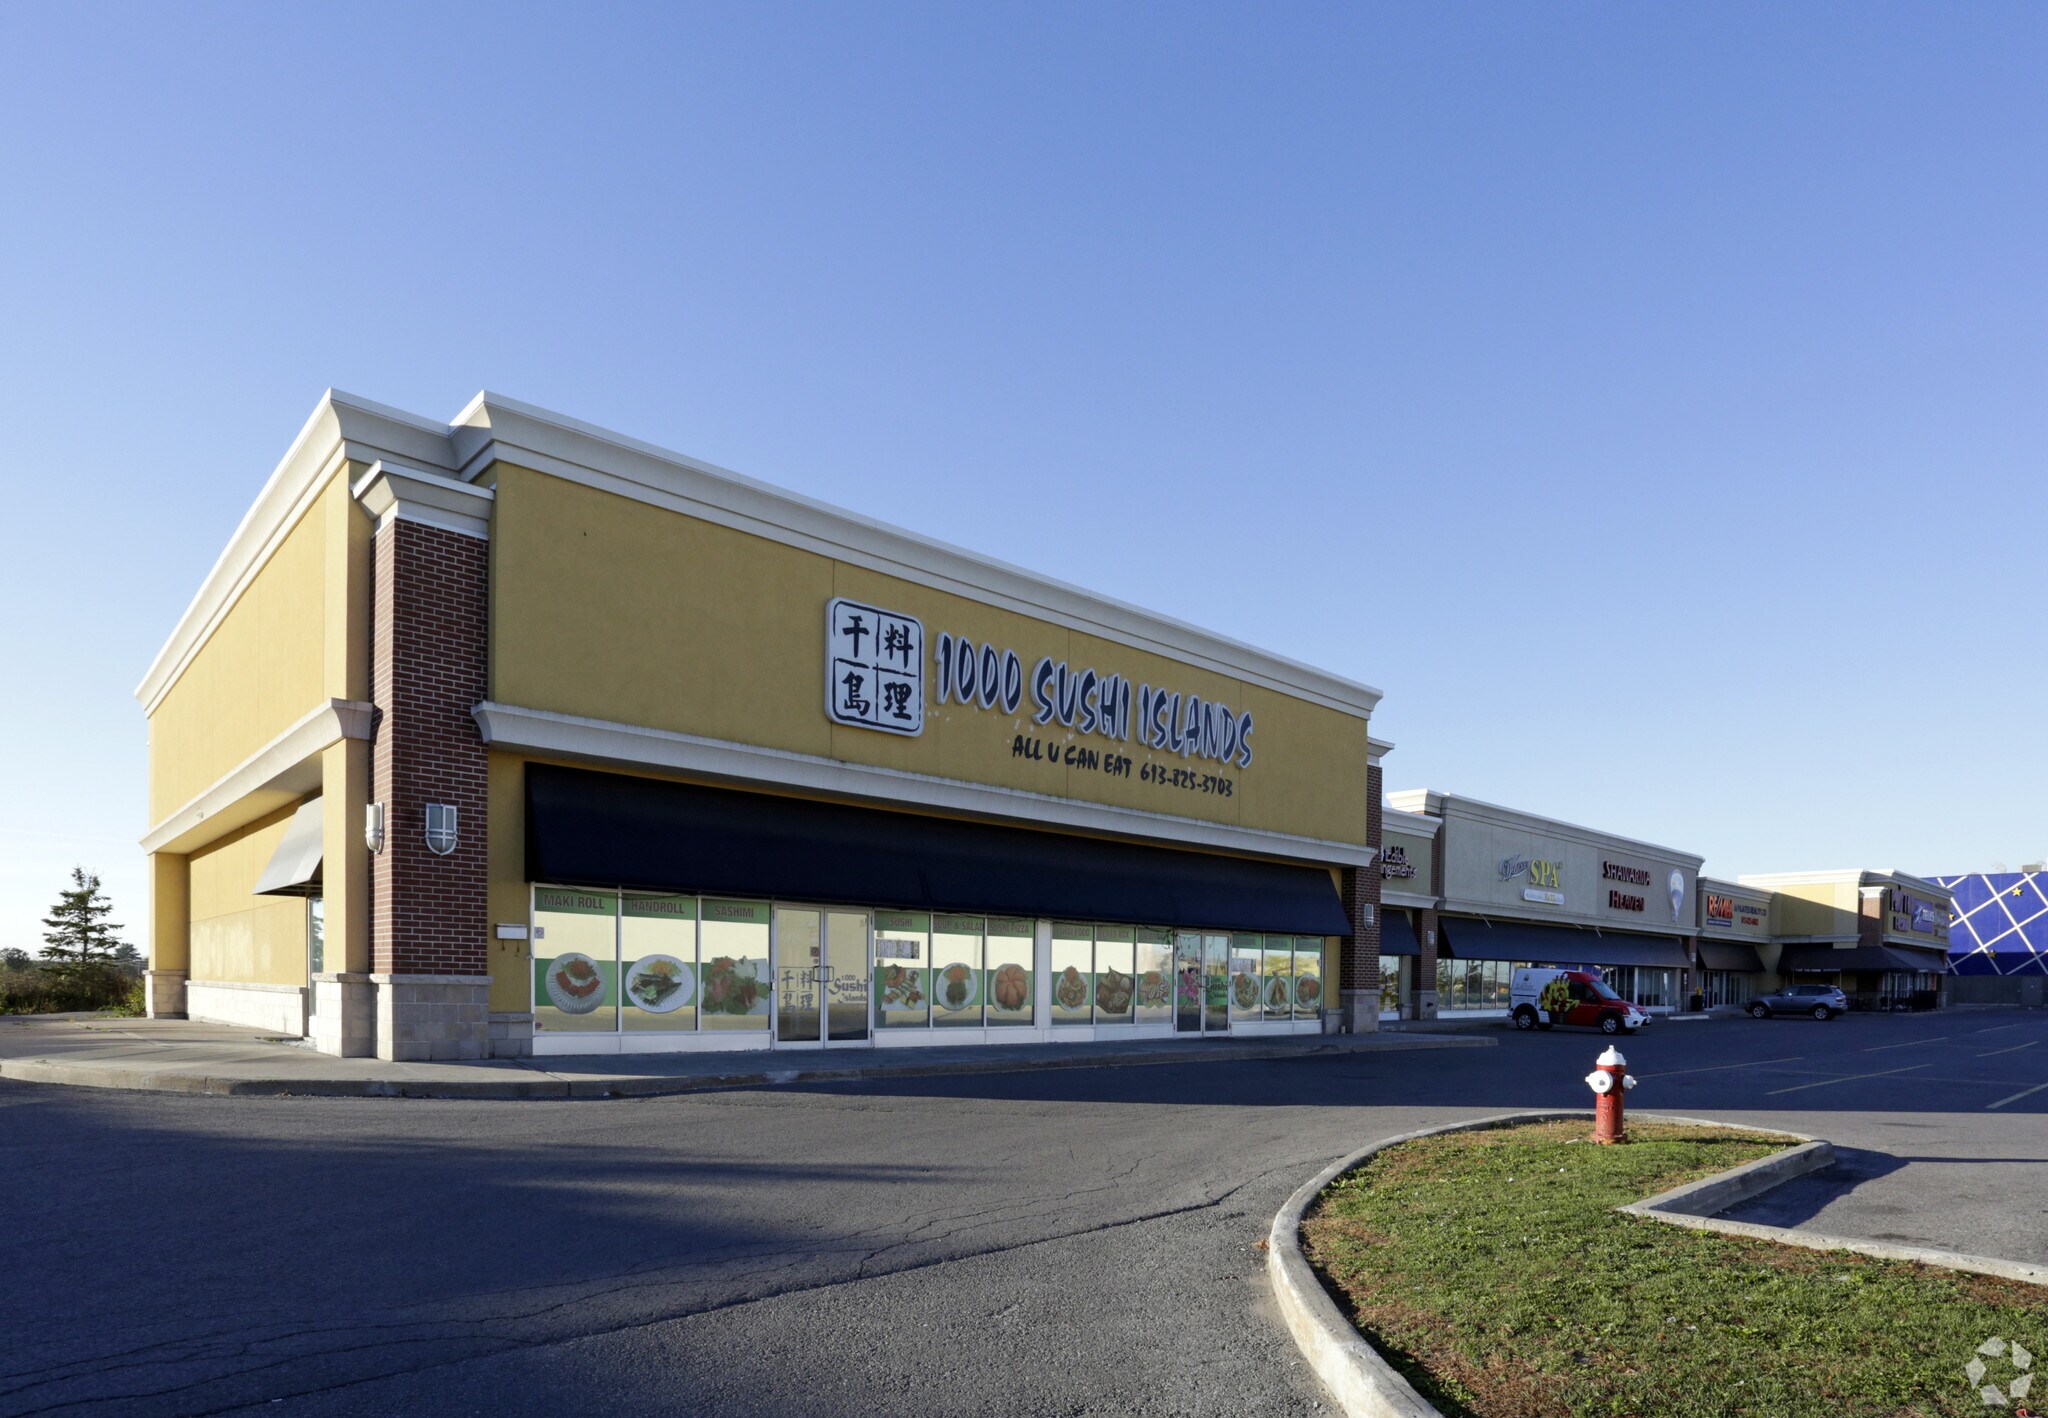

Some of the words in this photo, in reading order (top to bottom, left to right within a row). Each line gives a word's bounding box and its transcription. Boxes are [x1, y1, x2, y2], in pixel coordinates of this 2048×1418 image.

[935, 631, 1023, 715] 1000
[1030, 656, 1131, 742] SUSHI
[1136, 683, 1253, 769] ISLANDS
[1012, 734, 1043, 761] ALL
[1048, 741, 1060, 763] U
[1064, 745, 1099, 771] CAN
[1104, 753, 1132, 778] EAT
[1140, 762, 1233, 797] 613-825-3703
[1385, 846, 1409, 865] Edible
[1529, 859, 1560, 888] SPA
[1603, 861, 1652, 886] SHAWARMA
[544, 894, 574, 908] MAKI
[578, 896, 605, 910] ROLL
[631, 900, 685, 914] HANDROLL
[1609, 890, 1645, 912] HEAVEN
[714, 905, 754, 918] SASHIMI
[890, 916, 913, 927] SUSHI
[934, 919, 951, 929] SOUP
[962, 921, 984, 932] SALAD
[989, 922, 1009, 932] SUSHI
[1012, 923, 1029, 934] PIZZA
[829, 977, 868, 995] Sushi
